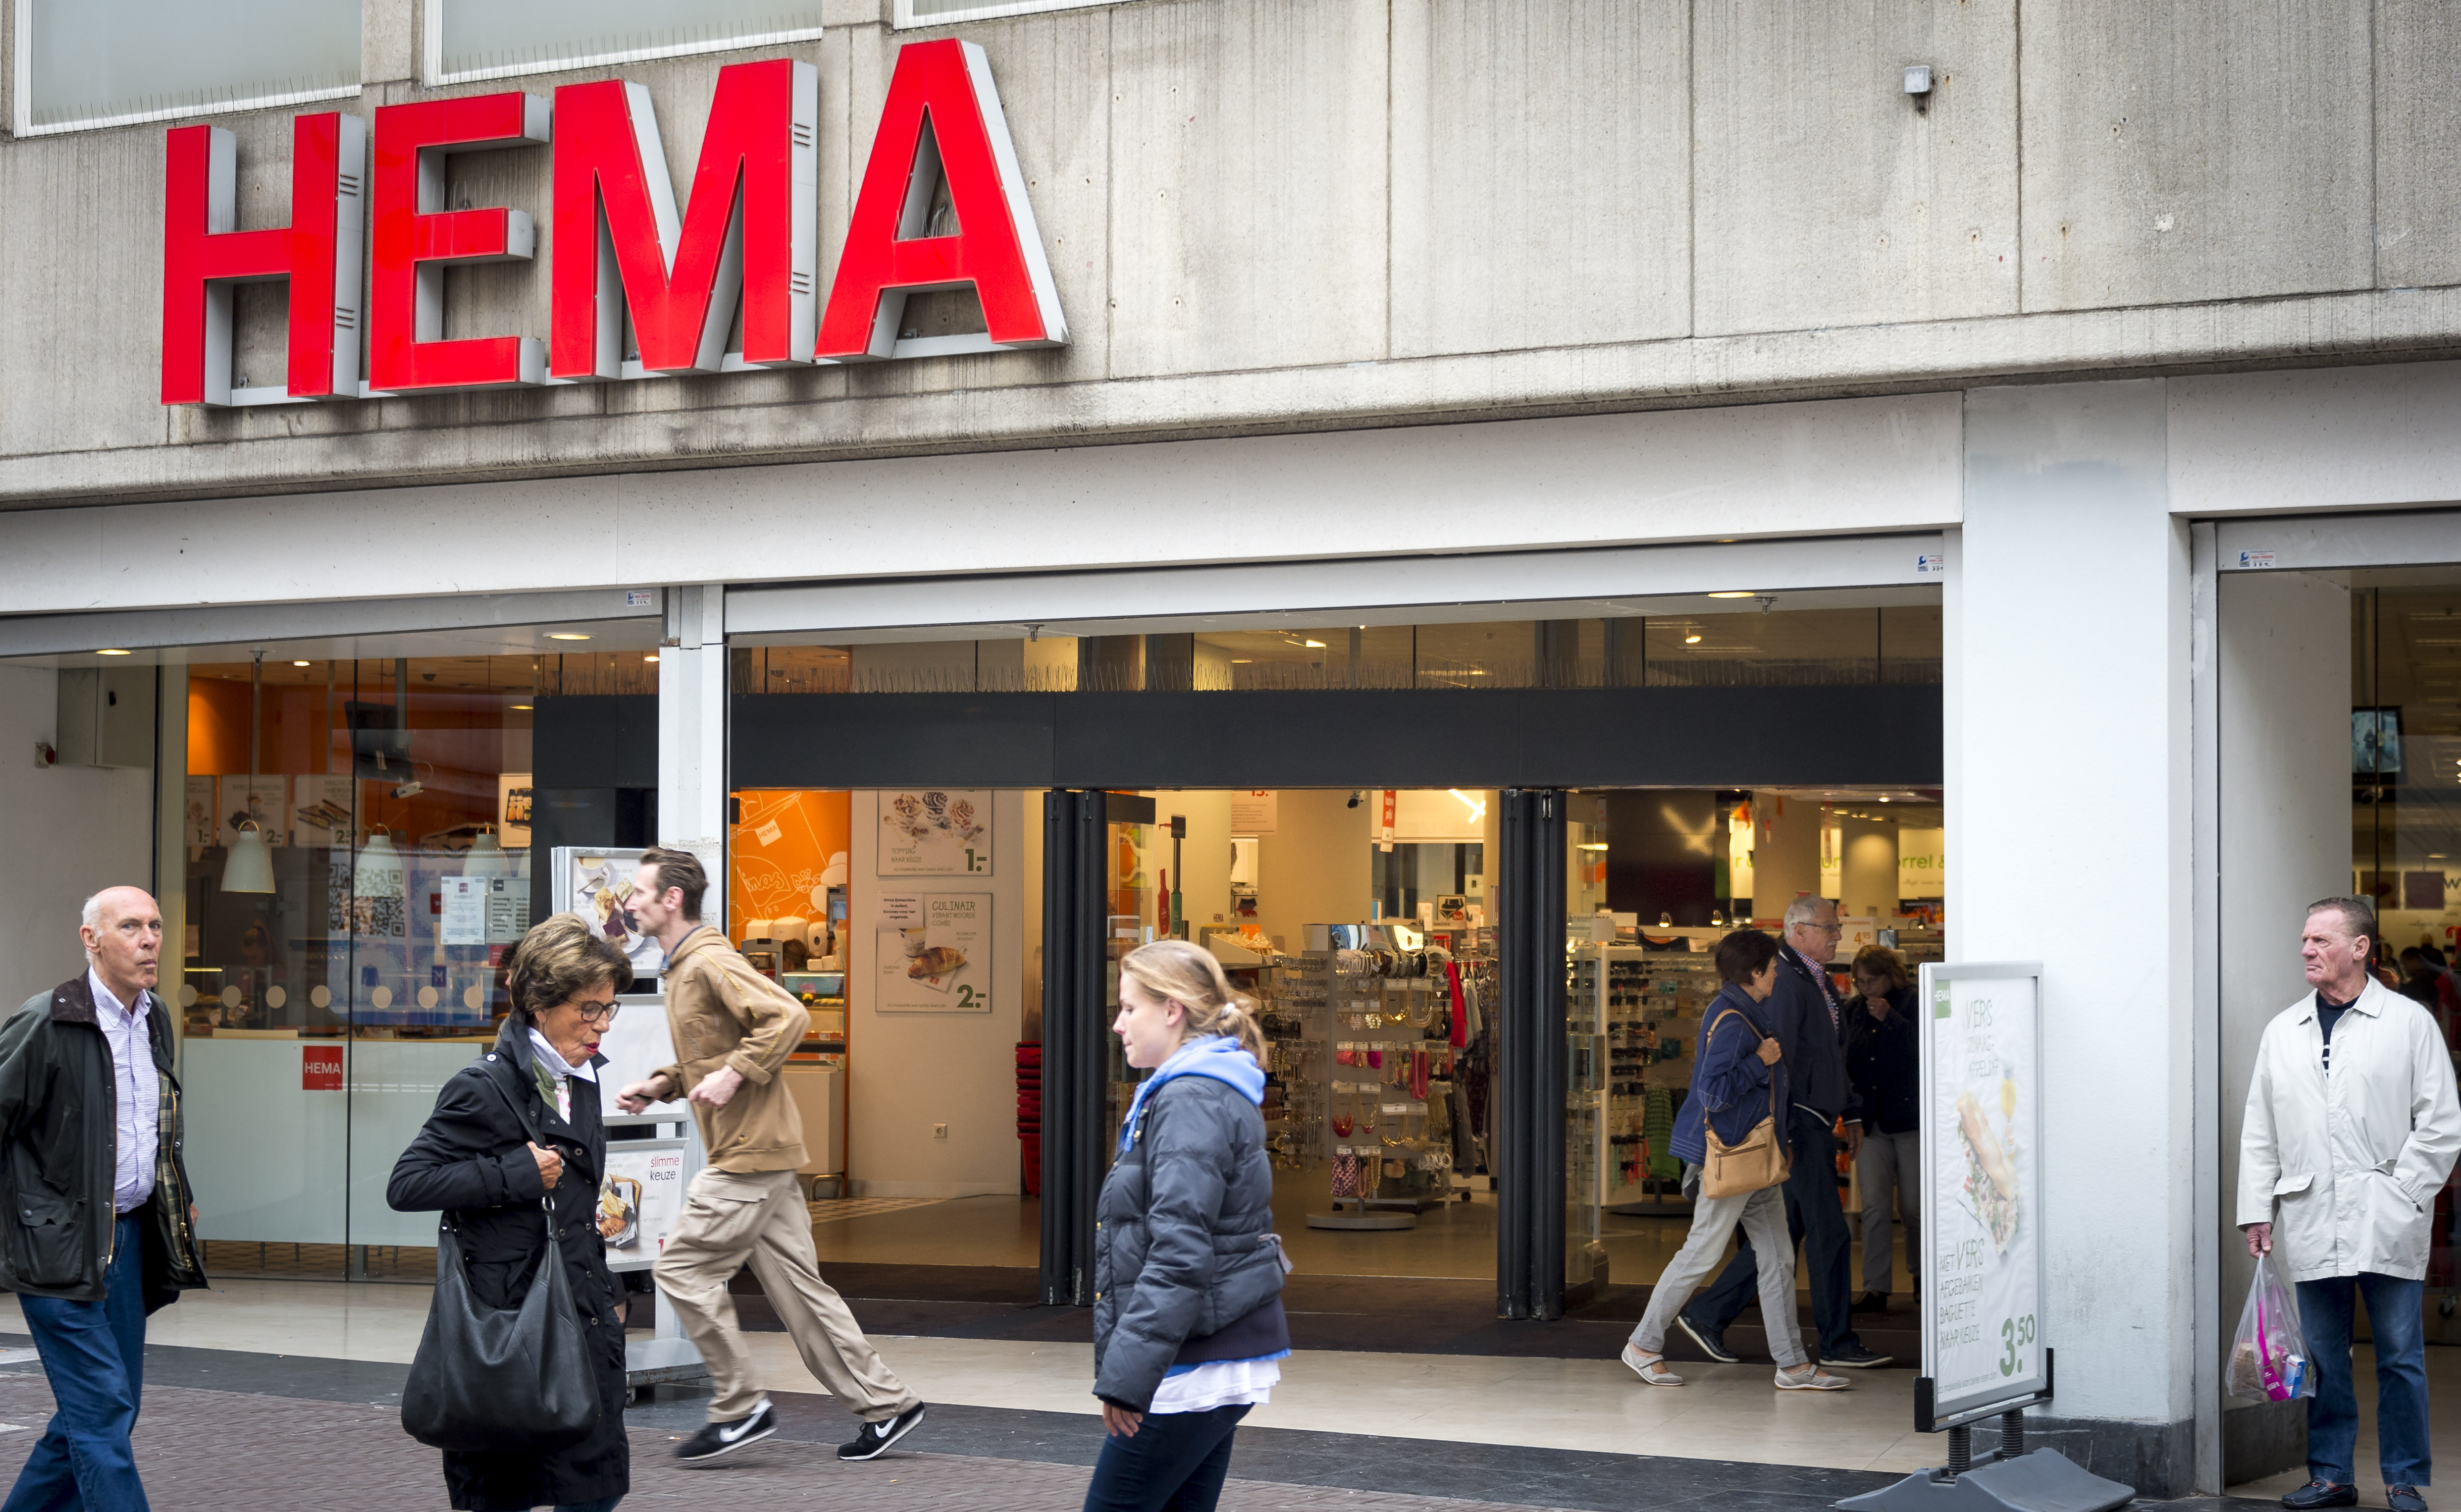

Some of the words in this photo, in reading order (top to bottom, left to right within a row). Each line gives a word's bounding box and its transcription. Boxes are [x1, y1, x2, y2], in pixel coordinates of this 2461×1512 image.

[162, 37, 1069, 406] HEMA
[758, 825, 778, 839] HEMA
[1898, 854, 1932, 869] rrel
[932, 901, 976, 911] CULINAIR
[1934, 990, 1950, 1002] HEMA
[1966, 999, 1992, 1030] VERS
[305, 1062, 341, 1074] HEMA
[1968, 1059, 1999, 1078] APPELSAP
[651, 1156, 679, 1168] slimme
[650, 1170, 676, 1181] keuze
[1940, 1254, 1955, 1273] MET
[1957, 1237, 1984, 1270] VERS
[1940, 1273, 1983, 1299] AFGEBAKKEN
[1940, 1300, 1976, 1324] BAGUETTE
[1940, 1328, 1959, 1351] NAAR
[1960, 1324, 1980, 1343] KEUZE
